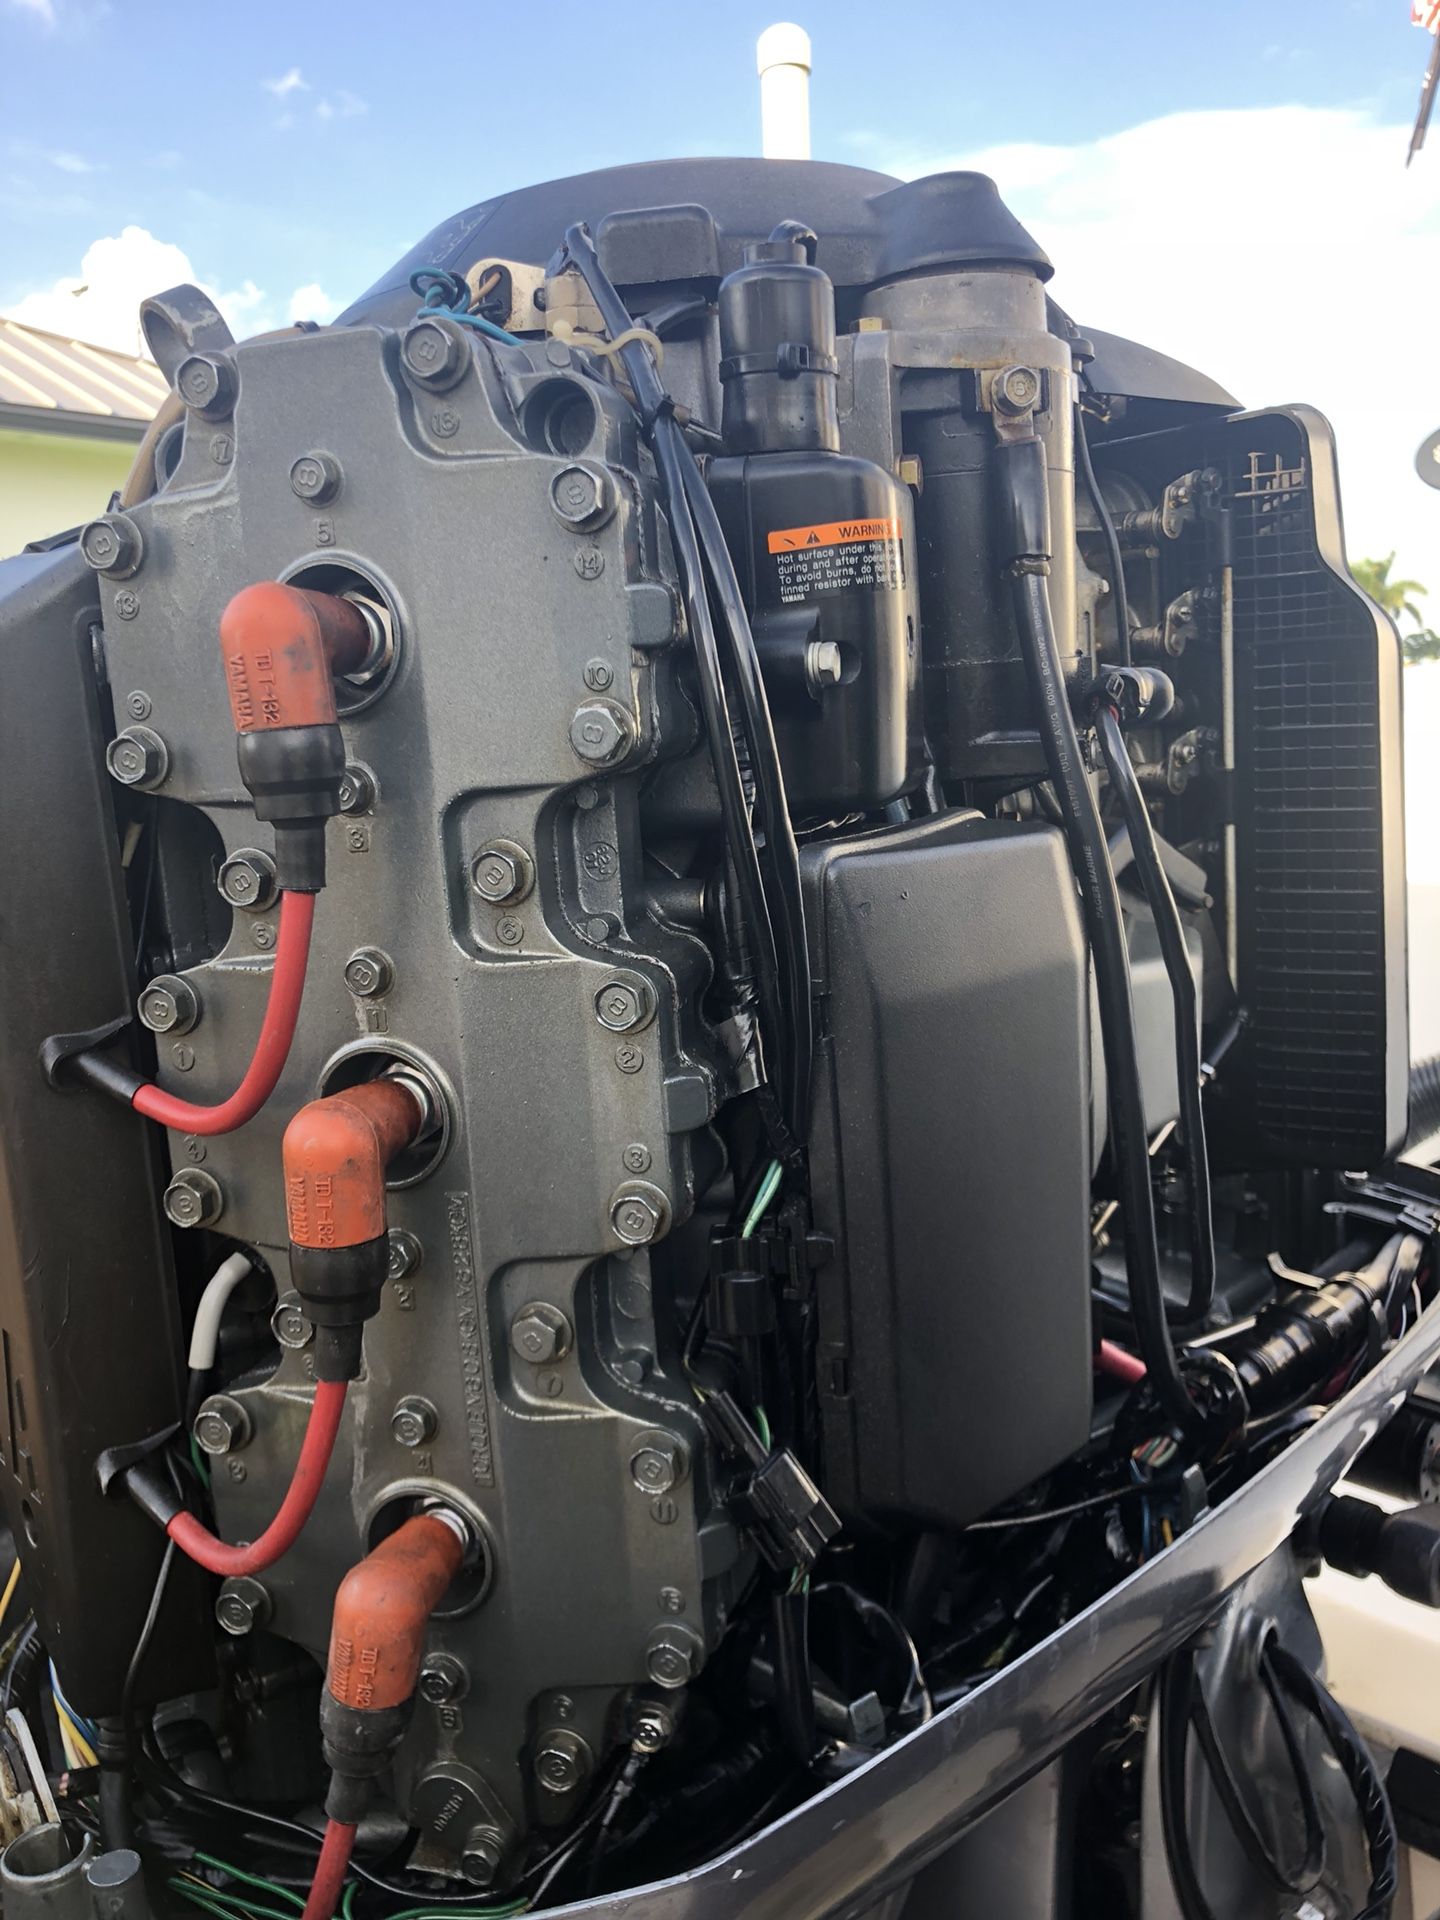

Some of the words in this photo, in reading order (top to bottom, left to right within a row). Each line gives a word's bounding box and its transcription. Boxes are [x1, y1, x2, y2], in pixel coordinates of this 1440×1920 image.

[776, 554, 795, 566] Hot
[798, 547, 834, 561] surface
[839, 543, 866, 556] under
[869, 543, 882, 554] this
[778, 562, 809, 577] during
[812, 558, 831, 571] and
[835, 555, 859, 568] after
[779, 575, 792, 586] To
[796, 571, 822, 583] avoid
[826, 566, 857, 580] burns,
[861, 564, 872, 575] do
[780, 583, 810, 596] finned
[814, 577, 851, 591] resistor
[856, 574, 874, 586] with
[781, 593, 806, 604] YAMAHA
[230, 655, 255, 729] YAMAHA
[1044, 683, 1056, 706] 600V
[1082, 844, 1099, 884] MARINE
